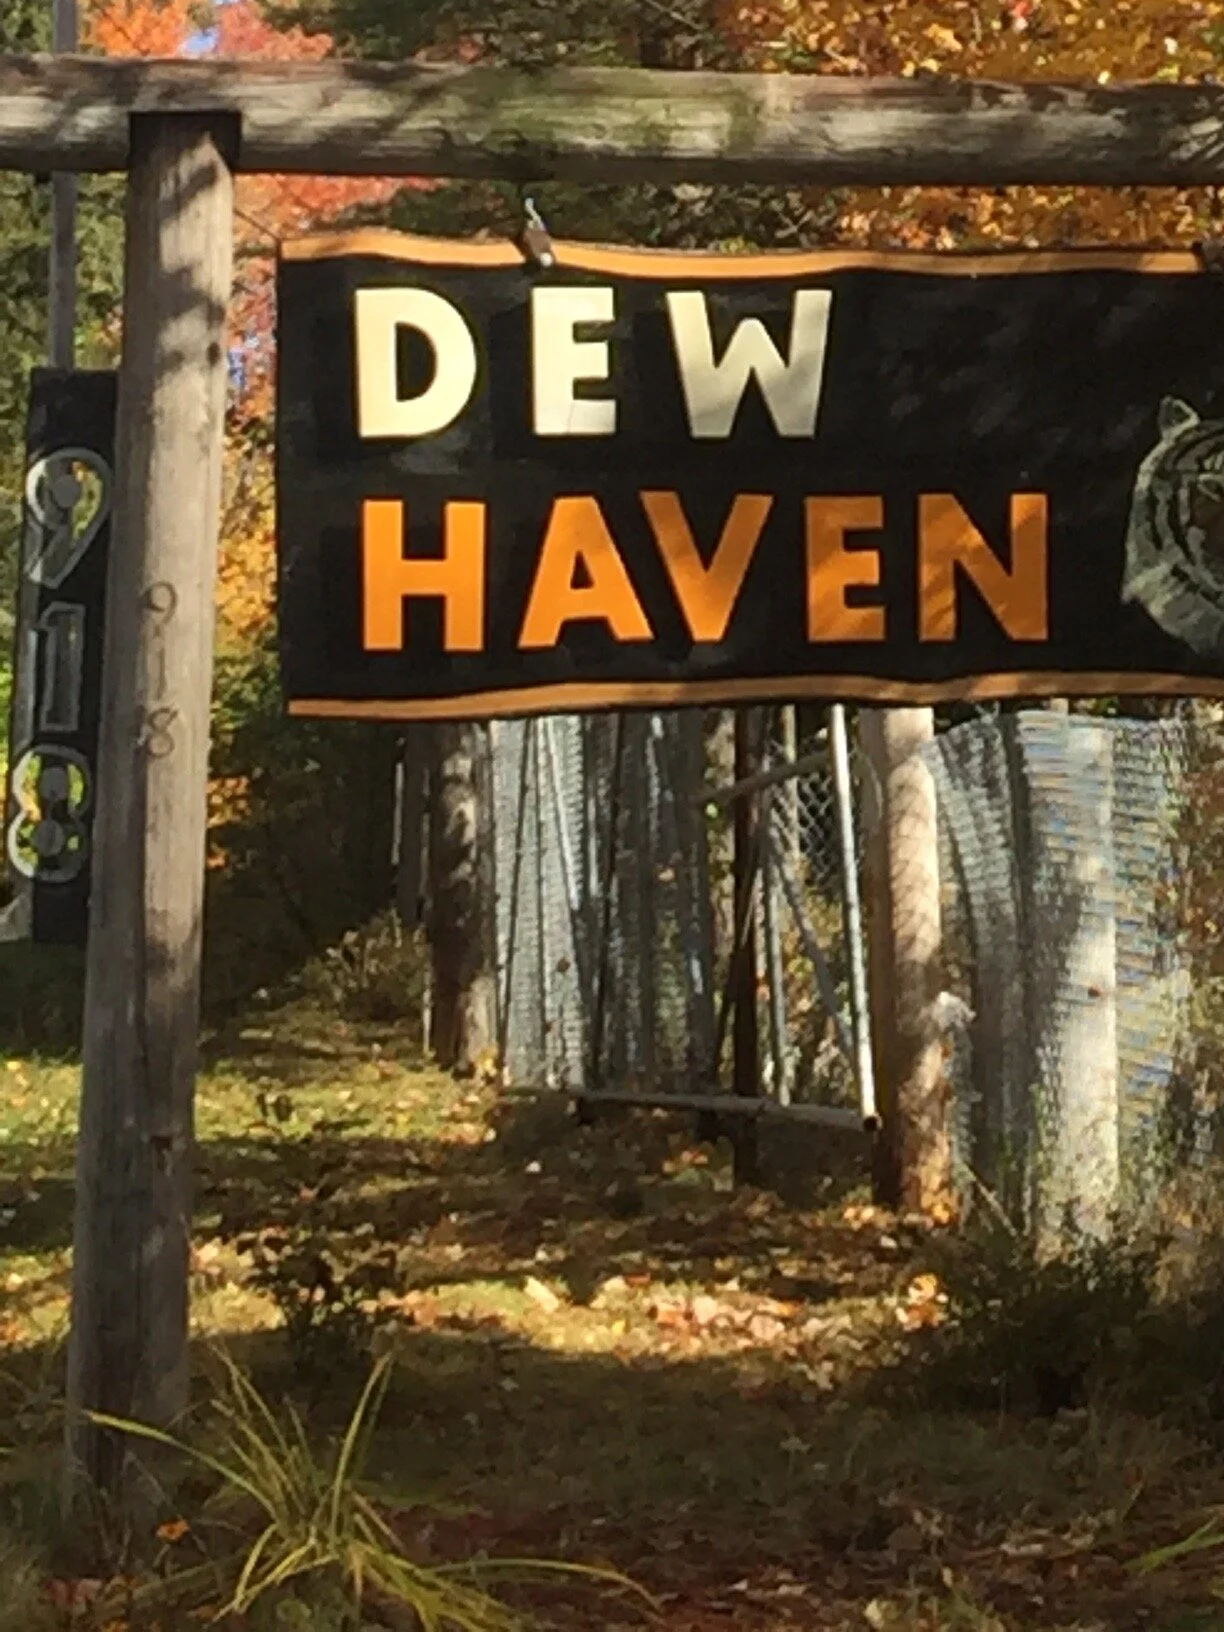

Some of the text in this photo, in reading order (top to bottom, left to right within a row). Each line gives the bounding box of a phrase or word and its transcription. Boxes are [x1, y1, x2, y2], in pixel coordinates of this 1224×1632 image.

[354, 286, 833, 439] DEW
[362, 491, 1049, 651] HAVEN
[9, 448, 112, 883] 918
[144, 580, 179, 759] 918
